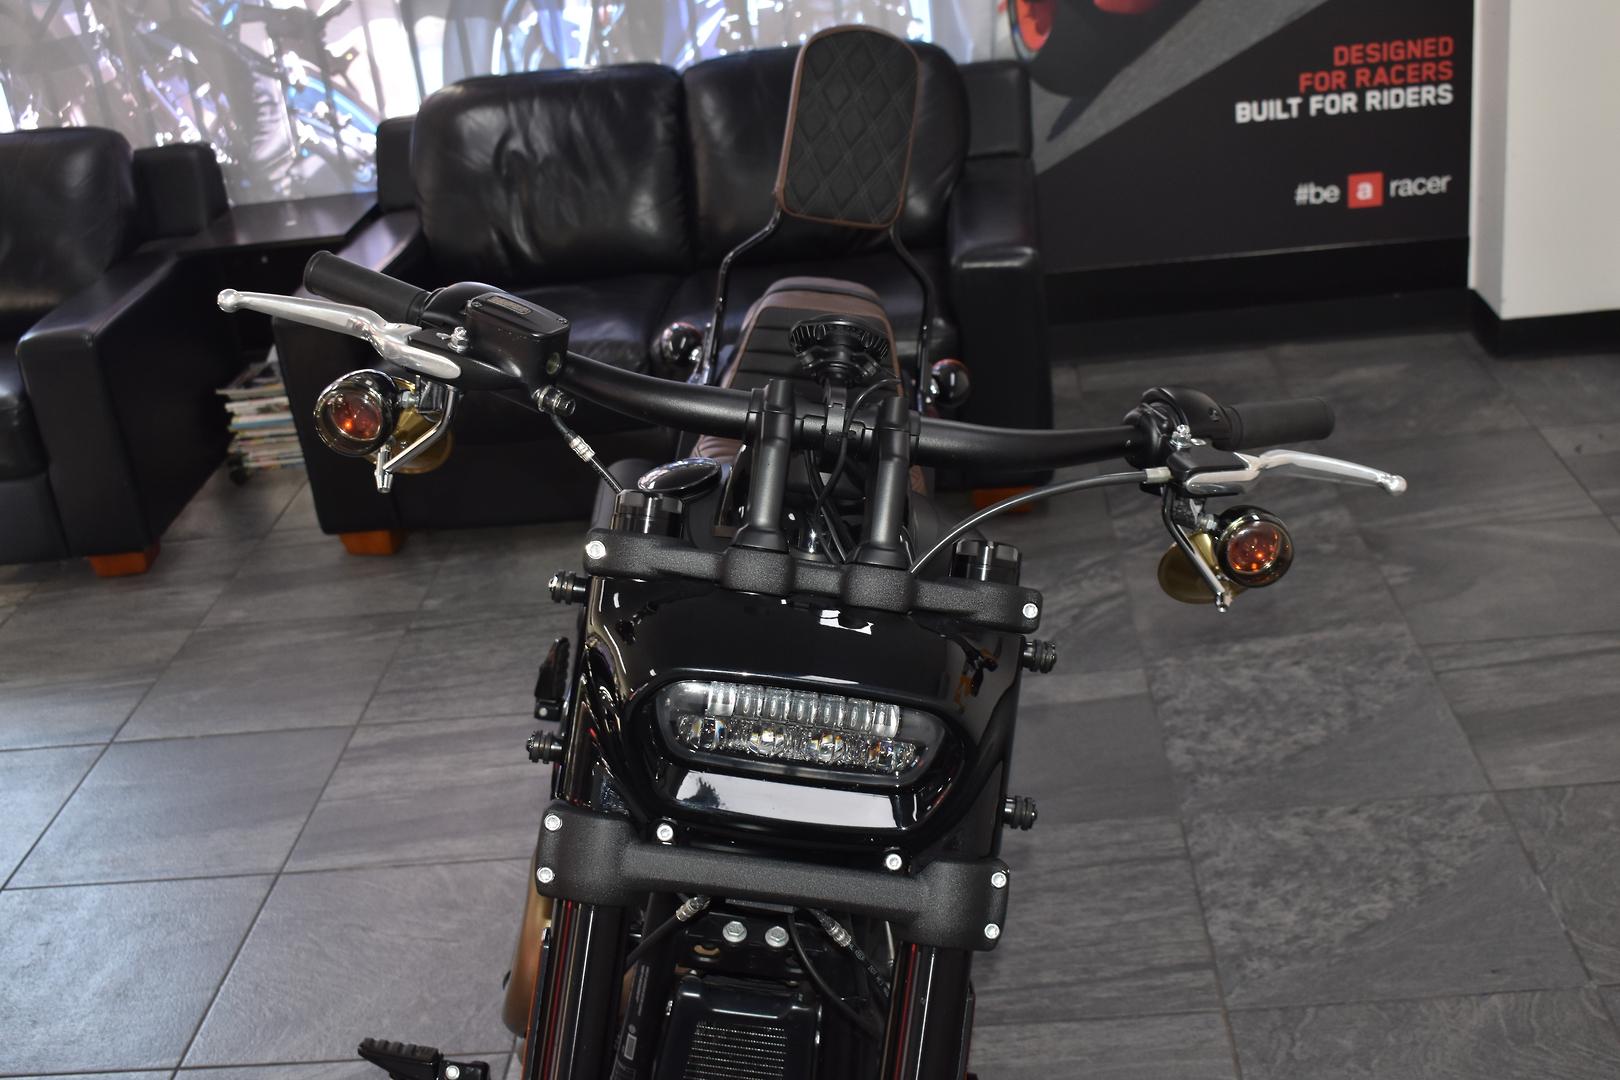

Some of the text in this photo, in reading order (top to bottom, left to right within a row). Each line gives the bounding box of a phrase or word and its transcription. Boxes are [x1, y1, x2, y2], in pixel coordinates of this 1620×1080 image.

[1333, 36, 1454, 67] DESIGNED
[1298, 61, 1454, 94] FOR RACERS
[1235, 83, 1454, 123] BUILT FOR RIDERS
[1294, 174, 1452, 206] #be a racer
